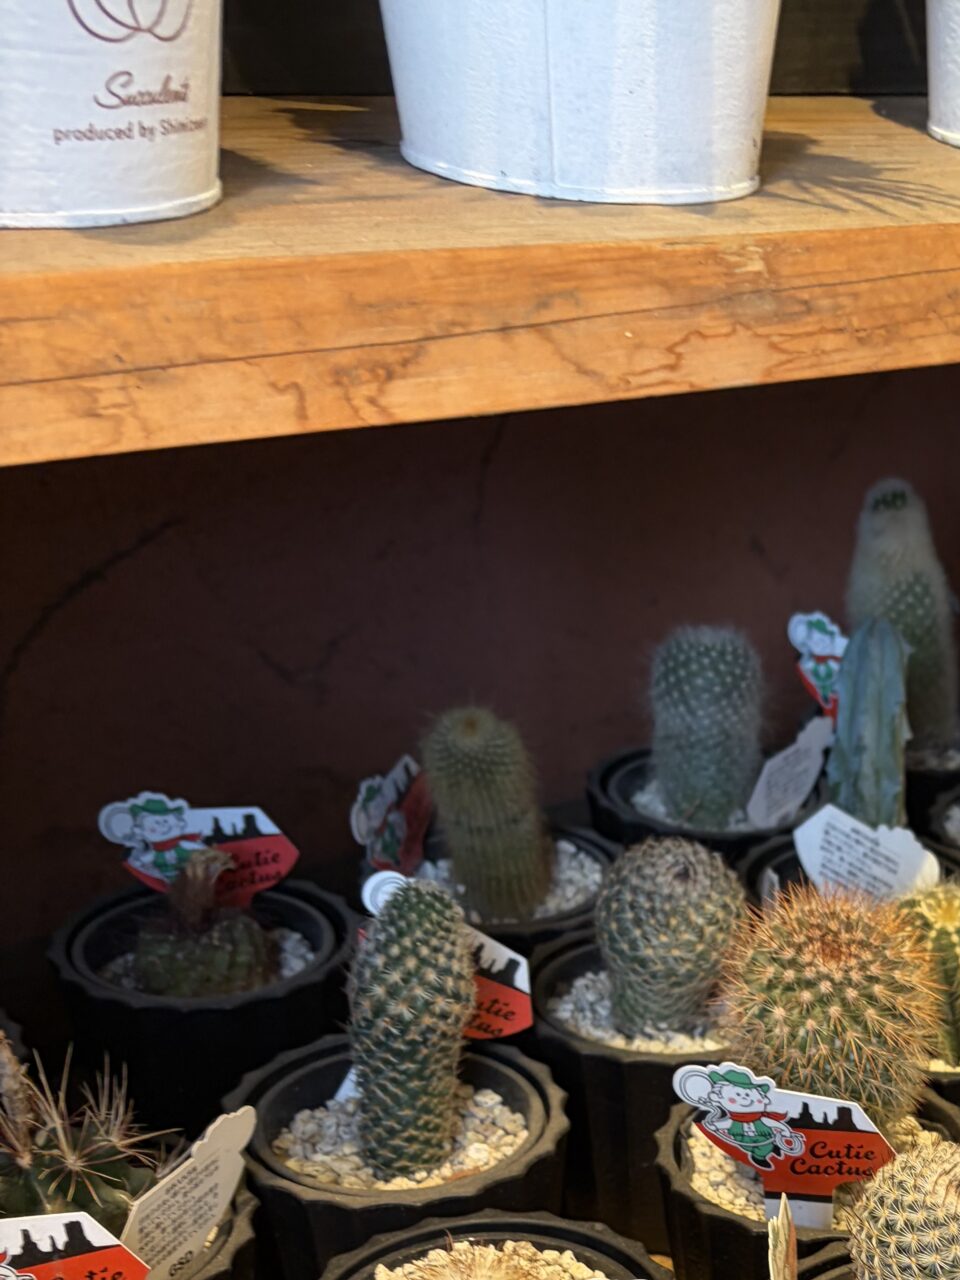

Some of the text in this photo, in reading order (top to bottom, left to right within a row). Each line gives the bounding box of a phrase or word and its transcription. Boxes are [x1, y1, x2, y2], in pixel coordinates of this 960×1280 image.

[53, 121, 134, 146] produced
[138, 119, 155, 141] by
[809, 1141, 876, 1160] Cutie
[790, 1158, 874, 1176] Cactus
